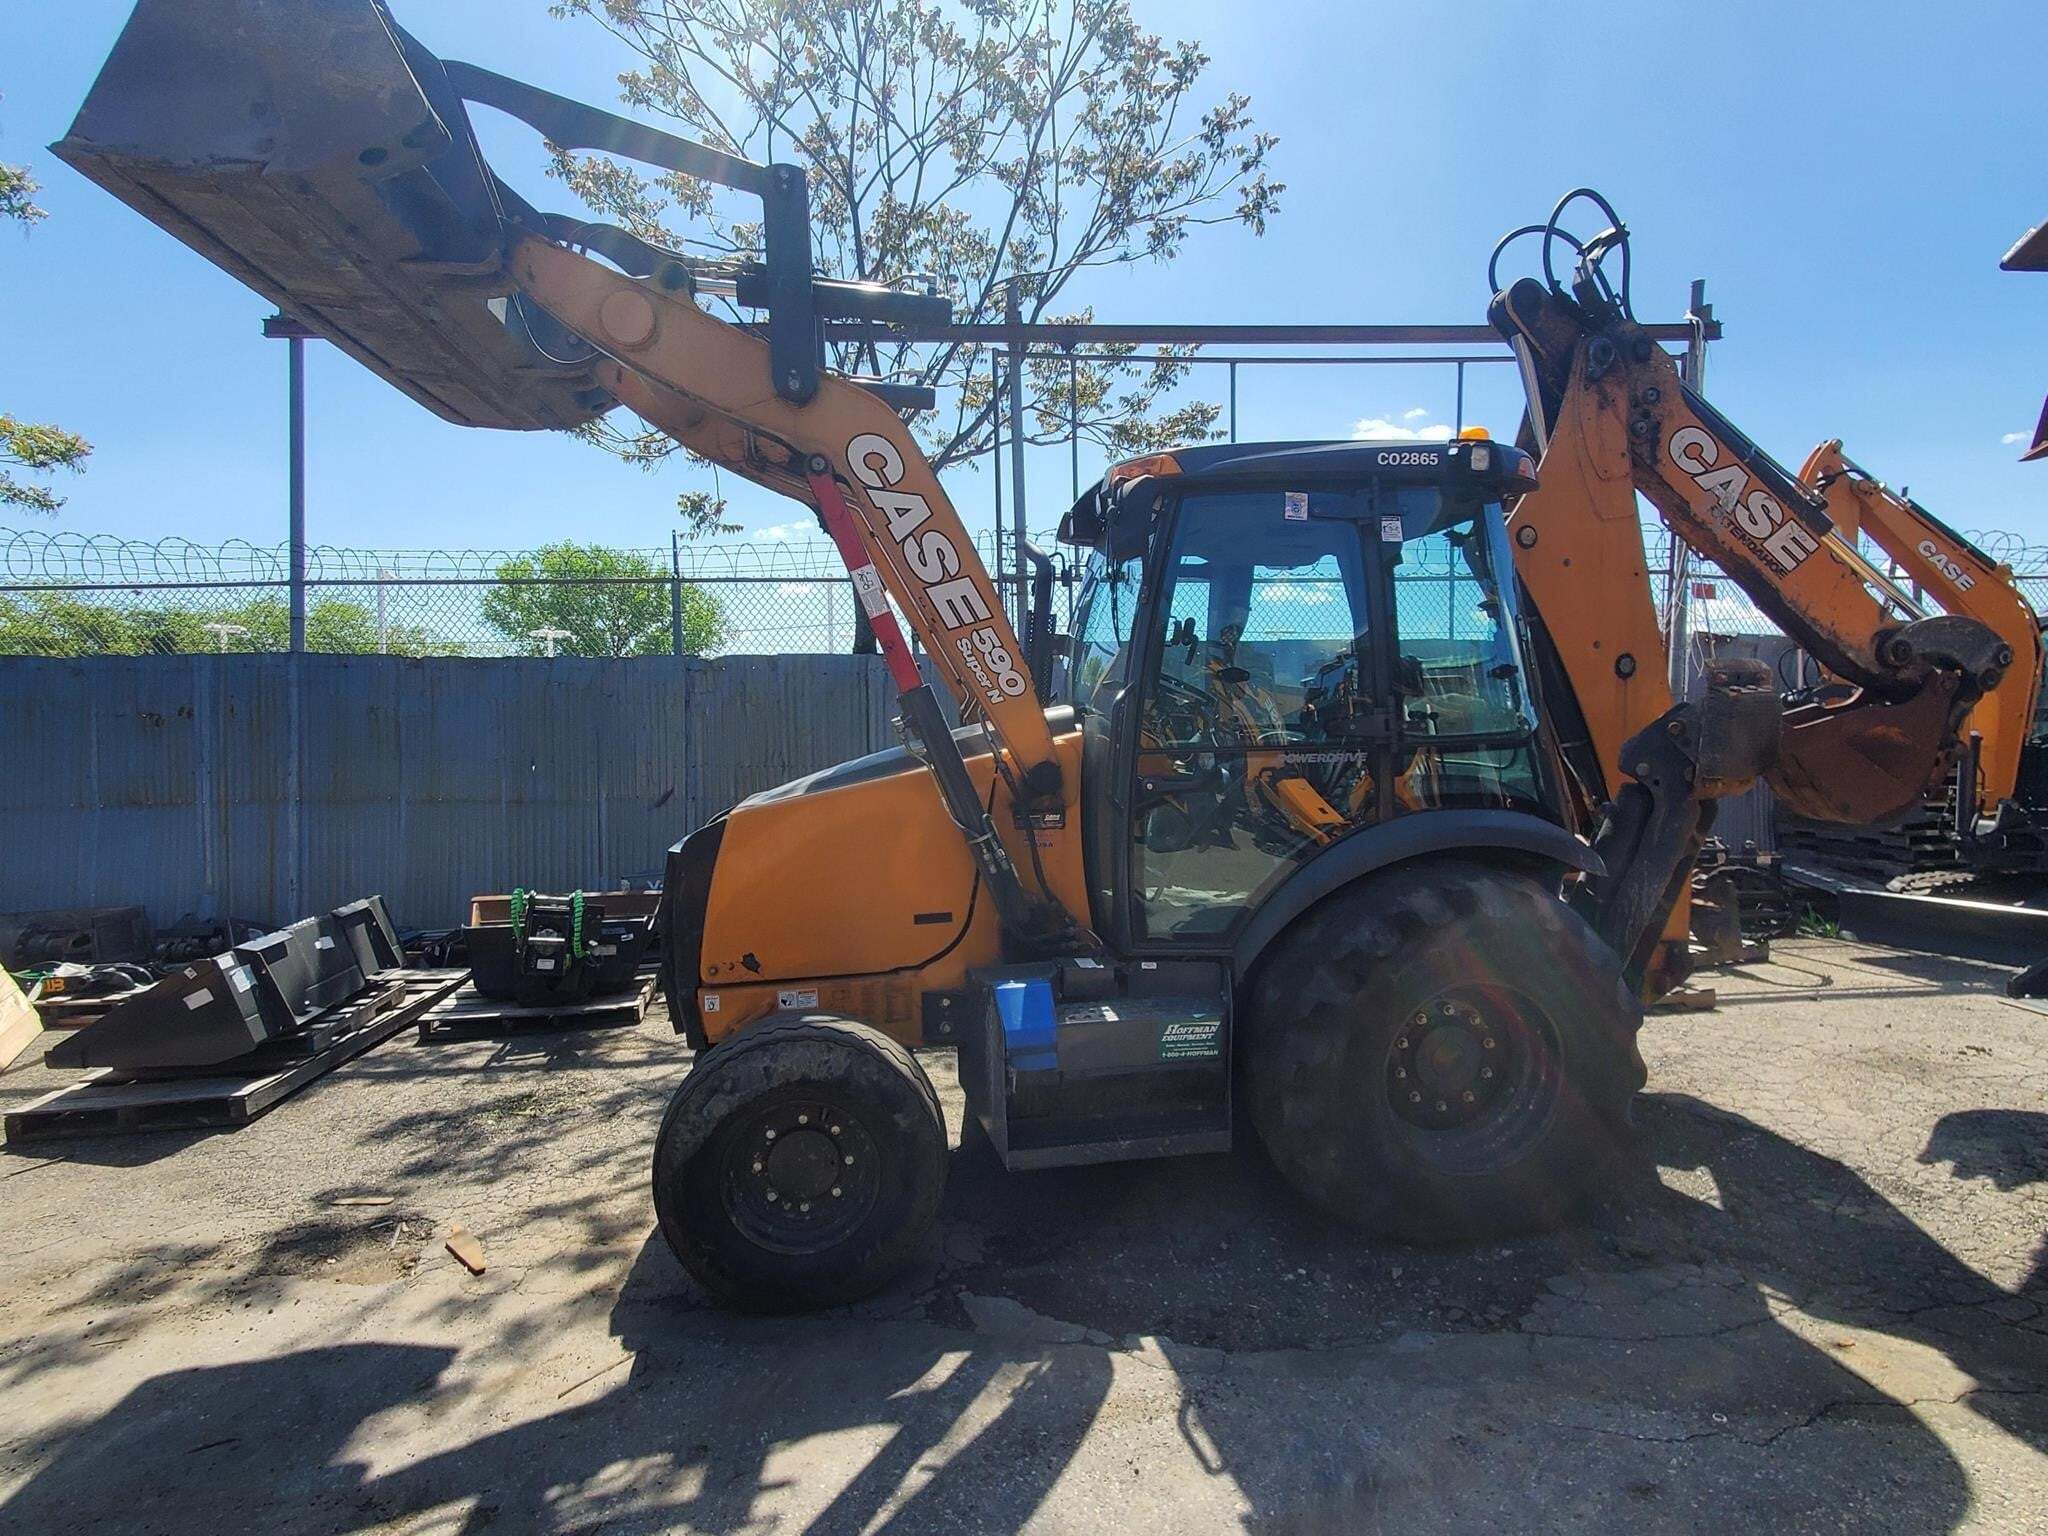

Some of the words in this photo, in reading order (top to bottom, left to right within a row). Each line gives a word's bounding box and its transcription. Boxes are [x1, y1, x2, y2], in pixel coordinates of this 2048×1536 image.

[846, 432, 993, 631] CASE
[1668, 425, 1820, 573] CASE
[1917, 538, 1976, 592] CASE
[956, 637, 993, 688] Super
[985, 688, 1006, 705] N
[971, 626, 1027, 697] 590
[1280, 751, 1368, 764] POWERDRIVE
